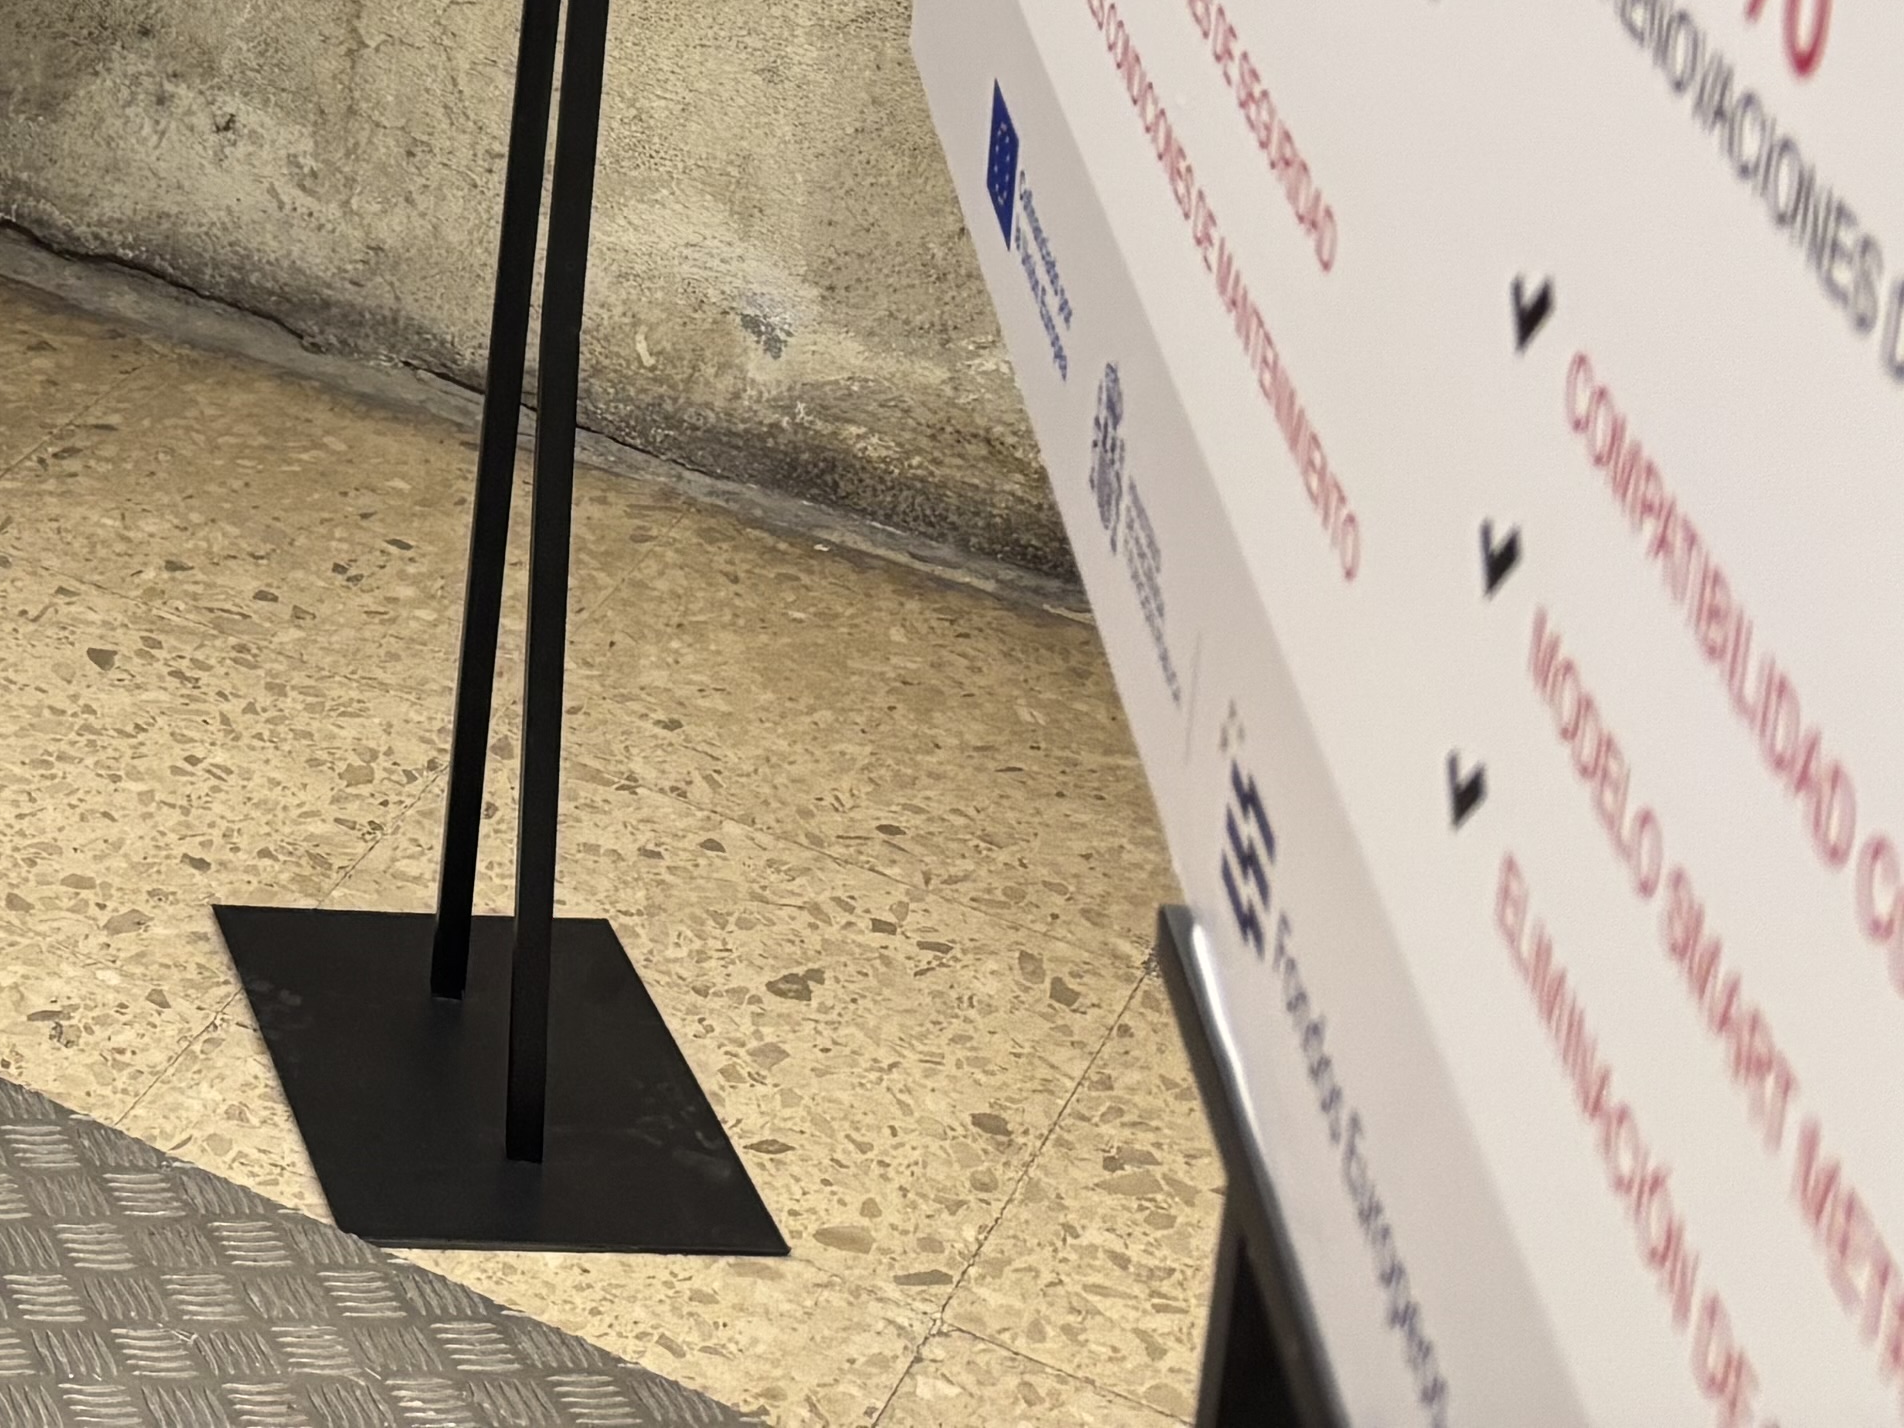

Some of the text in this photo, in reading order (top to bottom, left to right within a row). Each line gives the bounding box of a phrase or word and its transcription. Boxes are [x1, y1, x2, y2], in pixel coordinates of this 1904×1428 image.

[1106, 2, 1194, 220] CONDICIONES
[1192, 188, 1218, 272] DE
[1216, 236, 1358, 582] MANTENIMIENTO
[1212, 4, 1238, 86] DE
[1238, 50, 1334, 272] SEGURIDAD
[1568, 352, 1856, 866] COMPATIBILIDAD
[1496, 854, 1698, 1328] ELIMINACIÓN
[1532, 610, 1660, 898] MODELO
[1666, 868, 1796, 1146] SMART
